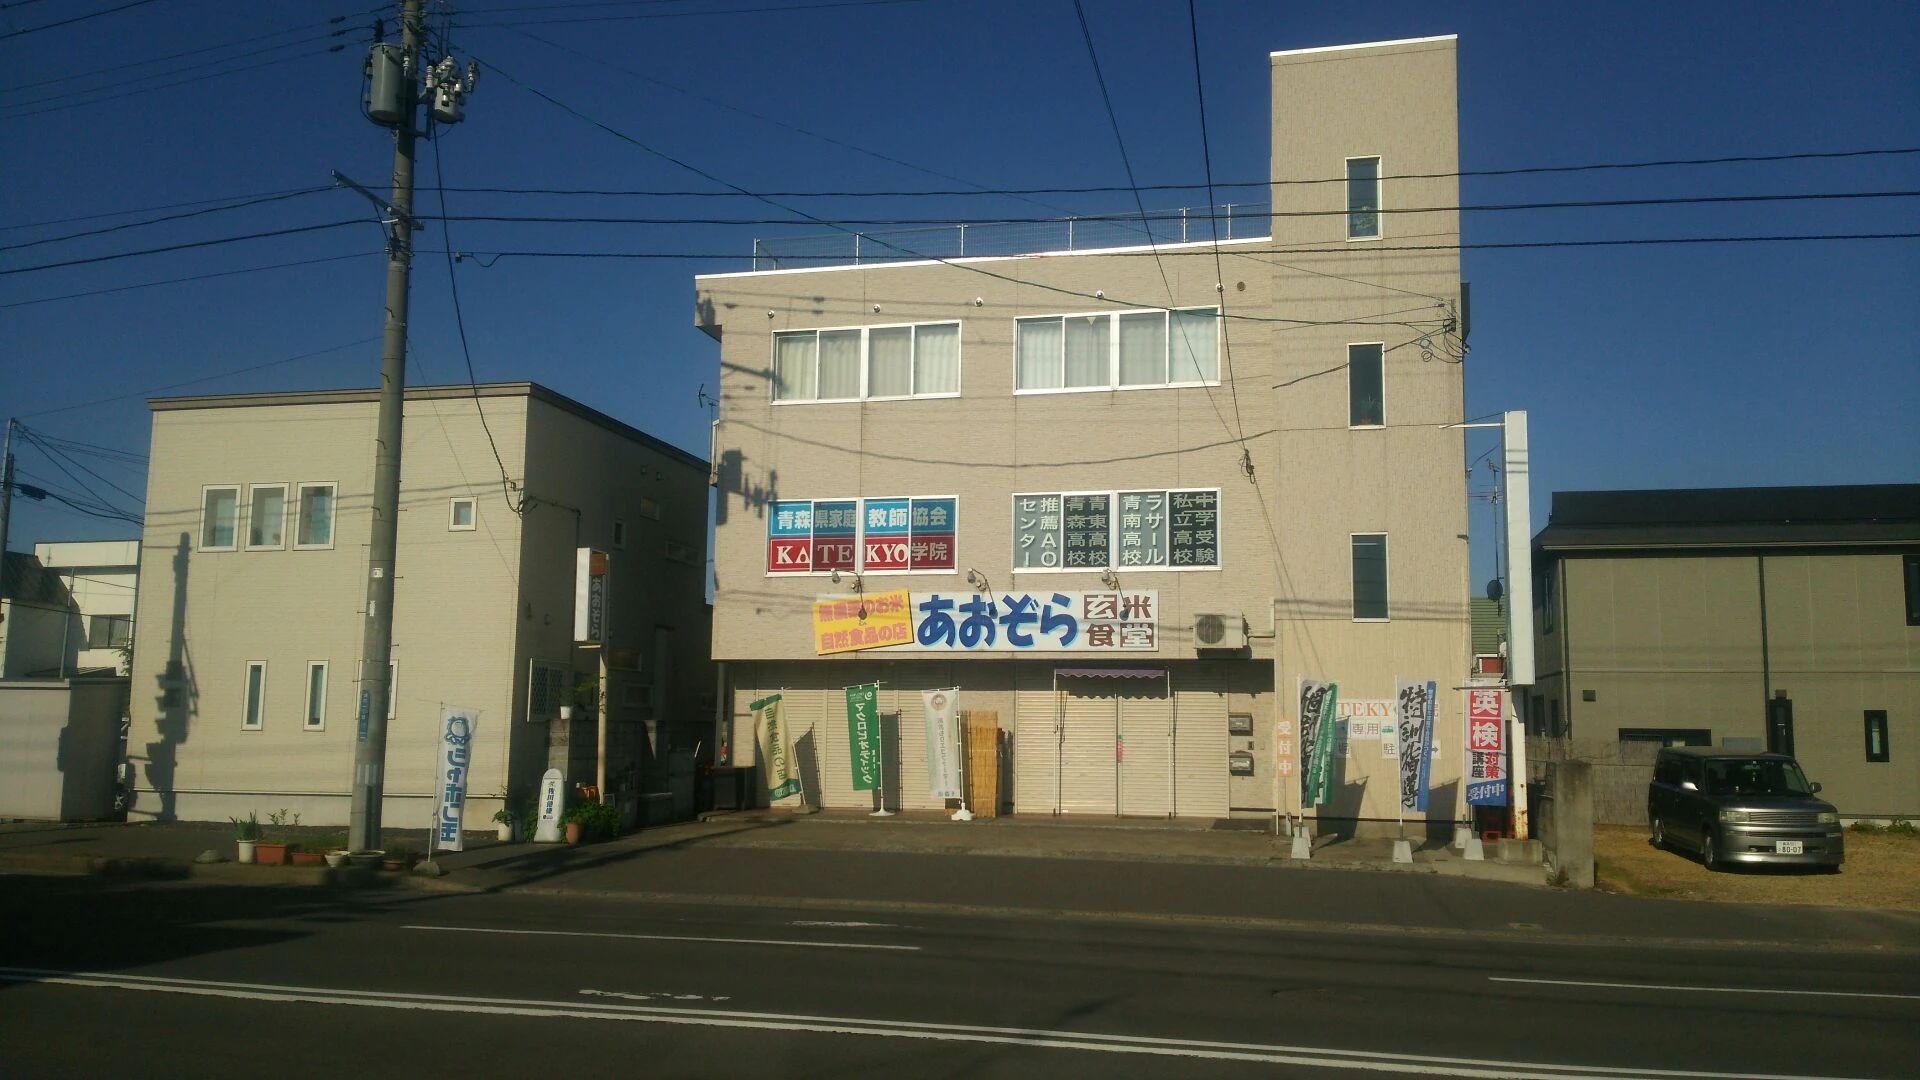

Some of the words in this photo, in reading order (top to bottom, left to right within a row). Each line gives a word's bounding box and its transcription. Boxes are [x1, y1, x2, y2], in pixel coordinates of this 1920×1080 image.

[777, 506, 947, 530] 青森県家庭教師協会
[1019, 499, 1036, 565] センター
[1040, 497, 1059, 567] 推薦AO
[1066, 496, 1086, 566] 青森高校
[1088, 496, 1107, 565] 青東高校
[1122, 495, 1141, 565] 青南高校
[1145, 494, 1164, 564] ラサール
[1173, 494, 1192, 564] 私立高校
[1195, 493, 1215, 563] 中学受験
[916, 592, 1080, 648] あおぞら
[1083, 594, 1152, 621] 玄米
[1083, 622, 1154, 648] 食堂
[820, 622, 908, 651] 自然食品の店
[1337, 702, 1398, 717] TEKY
[1352, 723, 1379, 735] 専用
[1473, 688, 1498, 747] 英検
[1468, 783, 1505, 801] 受付中
[1472, 751, 1485, 779] 講座
[1485, 751, 1500, 779] 対策
